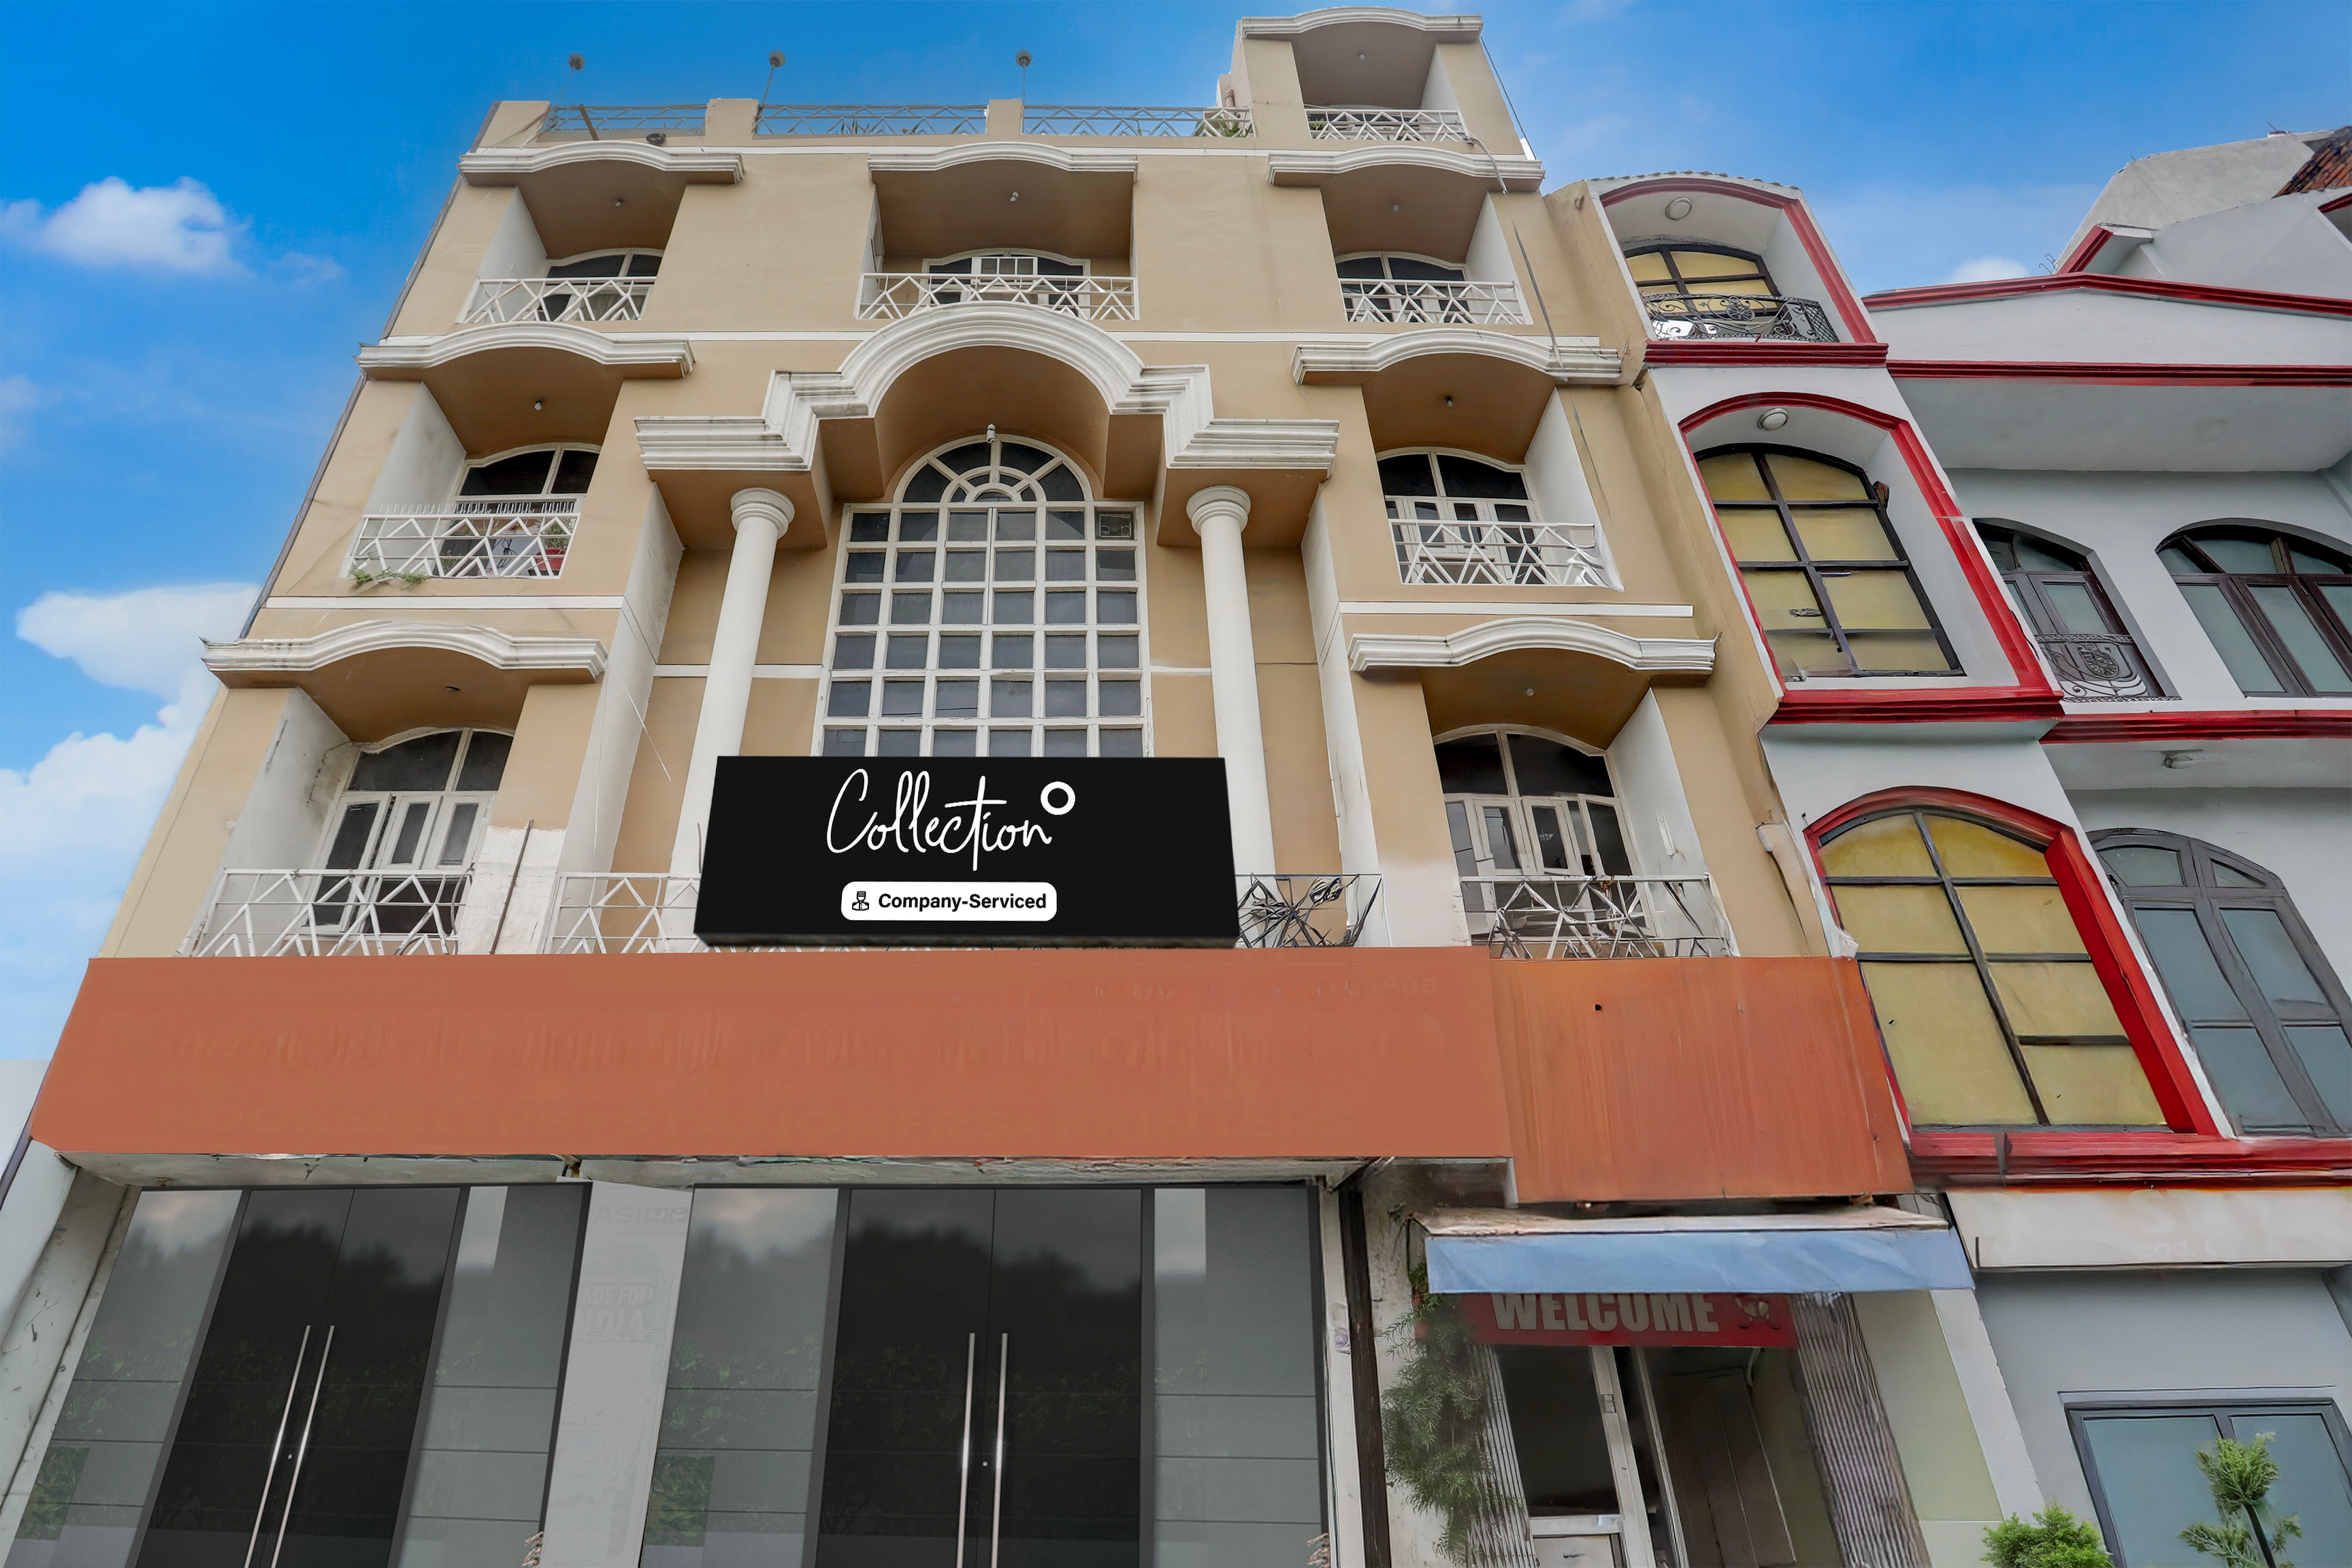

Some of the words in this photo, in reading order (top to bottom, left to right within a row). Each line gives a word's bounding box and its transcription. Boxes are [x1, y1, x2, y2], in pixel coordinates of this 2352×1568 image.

[826, 768, 1053, 872] Collection
[878, 893, 1047, 913] Company-Serviced
[1492, 1293, 1720, 1332] WELCOME
